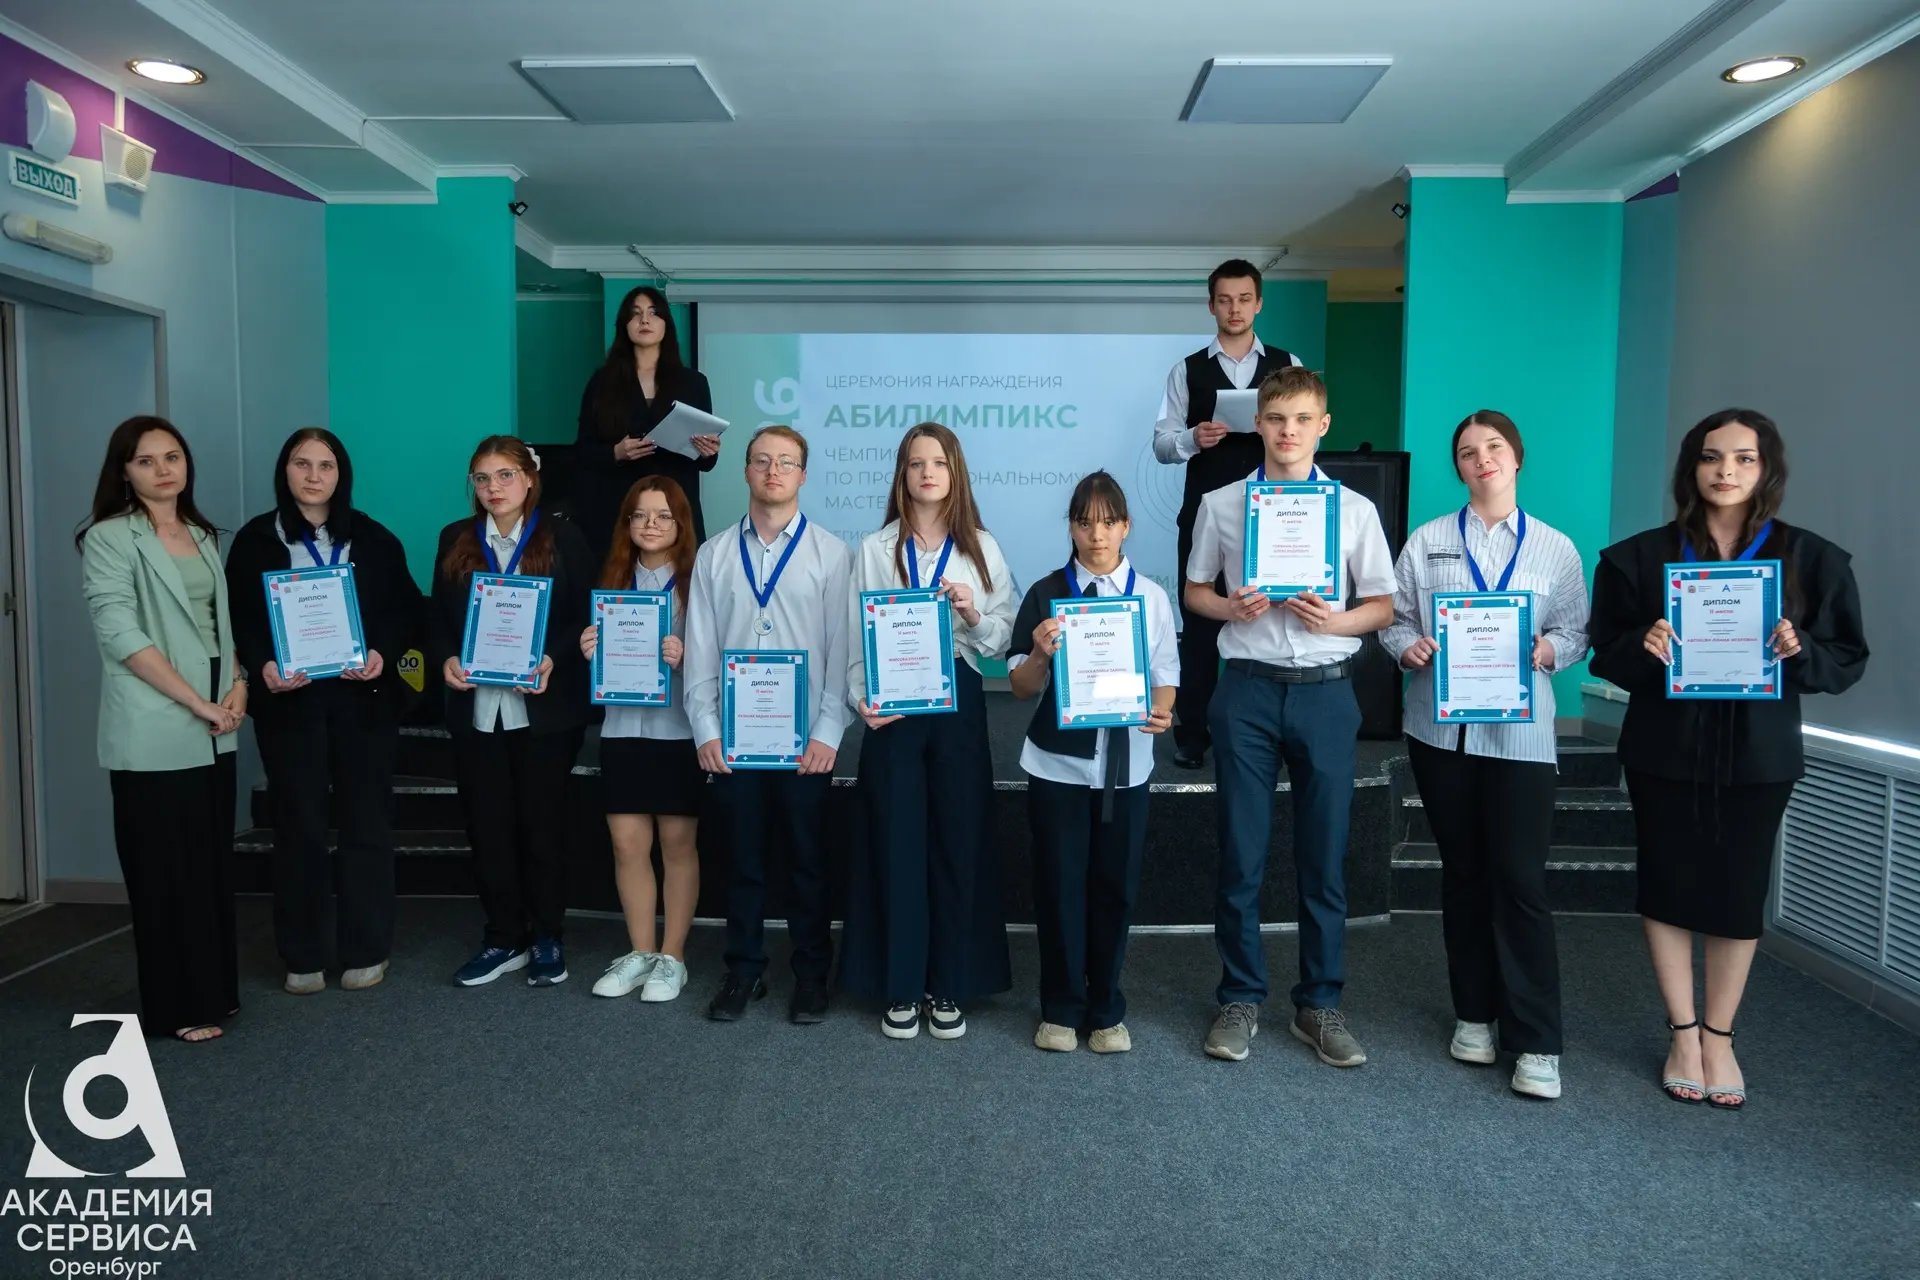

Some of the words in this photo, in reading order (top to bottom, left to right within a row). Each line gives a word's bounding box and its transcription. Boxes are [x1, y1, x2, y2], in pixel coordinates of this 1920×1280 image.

[18, 161, 74, 198] ВЫХОД
[826, 375, 932, 389] ЦЕРЕМОНИЯ
[937, 375, 1062, 390] НАГРАЖДЕНИЯ
[823, 404, 1078, 428] АБИЛИМПИКС
[826, 471, 852, 485] ПО
[825, 495, 888, 509] МАСТЕ
[892, 620, 922, 628] ДИПЛОМ
[1084, 631, 1116, 639] ДИПЛОМ
